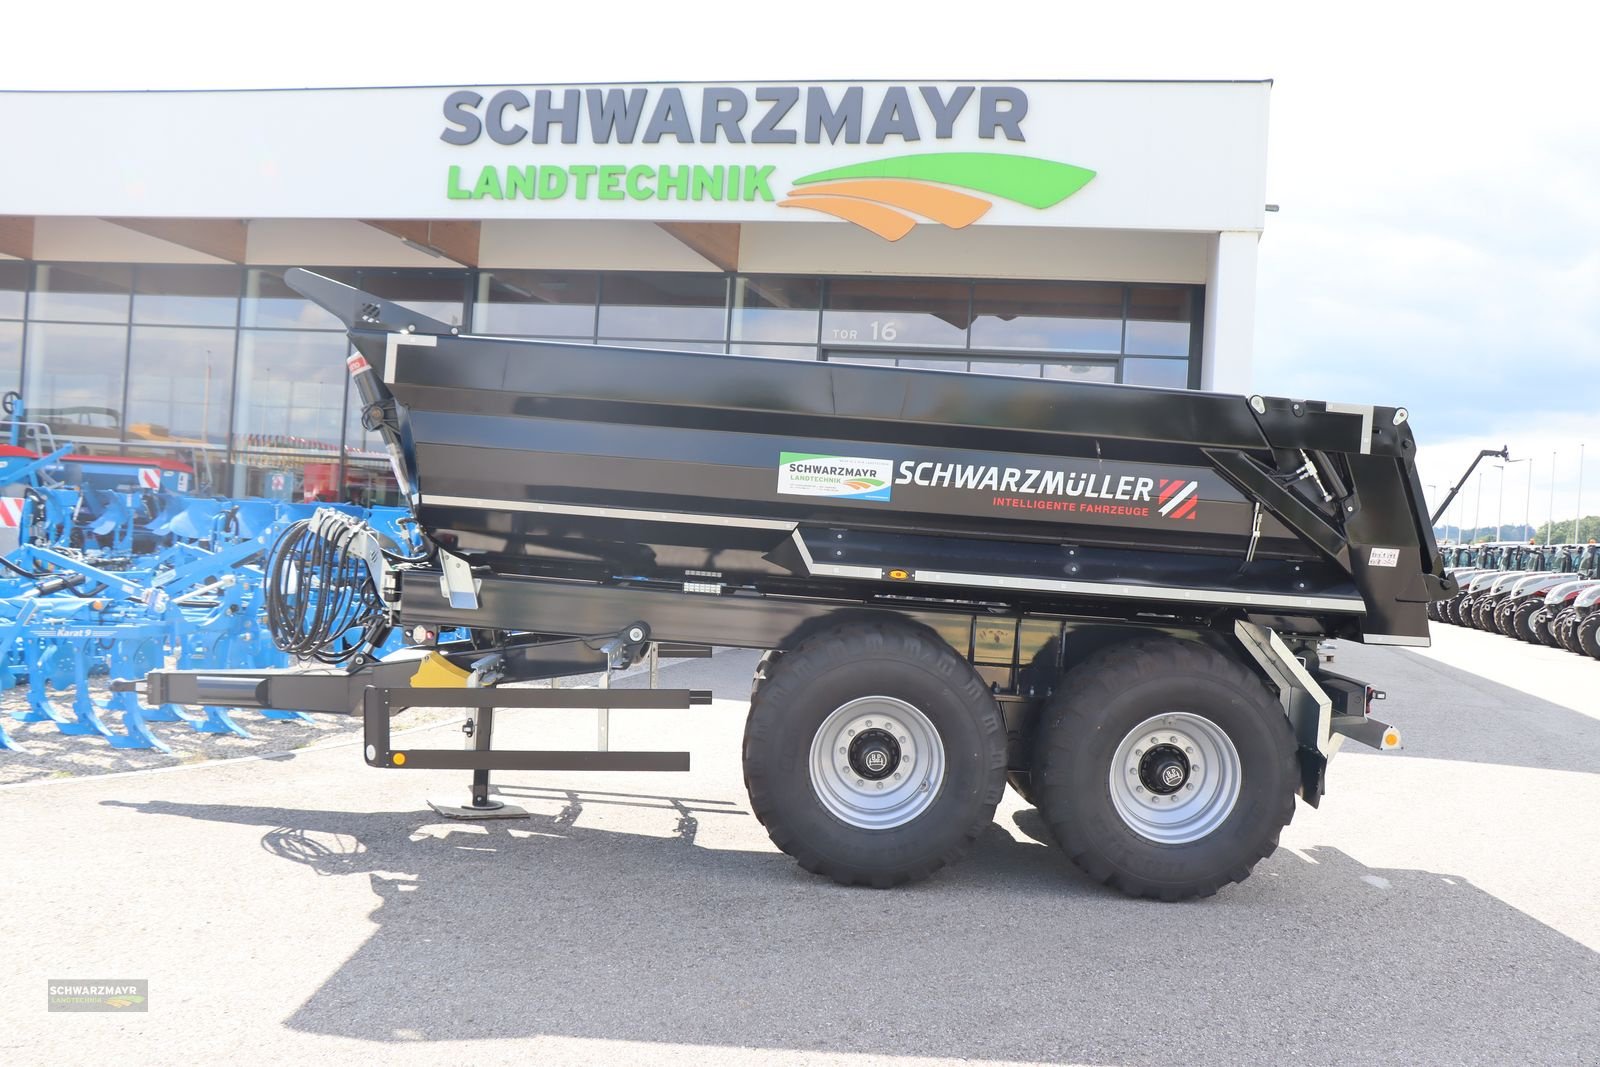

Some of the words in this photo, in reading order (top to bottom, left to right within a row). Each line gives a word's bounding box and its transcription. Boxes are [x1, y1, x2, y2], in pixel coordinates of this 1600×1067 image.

[440, 85, 1029, 146] SCHWARZMAYR
[446, 163, 777, 203] LANDTECHNIK
[832, 329, 858, 340] TOR
[870, 320, 897, 341] 16
[789, 463, 877, 478] SCHWARZMAYR
[789, 474, 842, 484] LANDTECHNIK
[992, 496, 1077, 512] INTELLIGENTE
[1079, 503, 1150, 517] FAHRZEUGE
[56, 628, 83, 637] Karat
